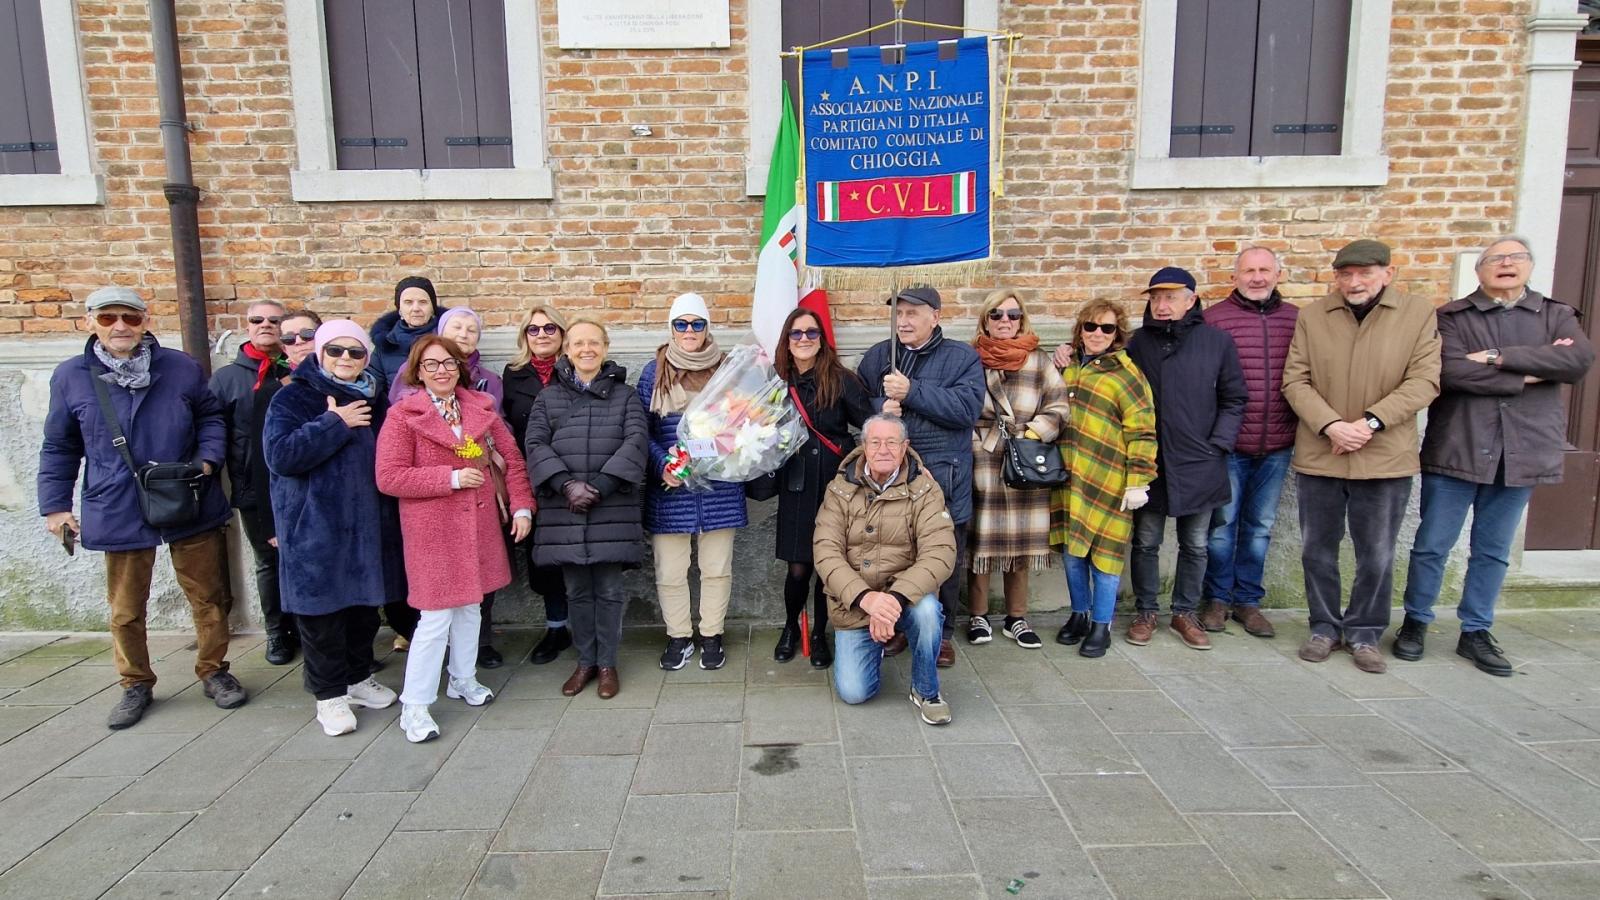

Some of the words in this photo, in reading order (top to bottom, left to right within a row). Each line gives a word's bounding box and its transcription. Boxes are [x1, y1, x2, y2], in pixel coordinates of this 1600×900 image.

[809, 97, 903, 116] ASSOCIAZIONE
[908, 91, 984, 111] NAZIONALE
[823, 116, 903, 133] PARTIGIANI
[909, 112, 970, 129] D'ITALIA
[810, 135, 878, 151] COMITATO
[886, 130, 964, 147] COMUNALE
[970, 127, 984, 141] DI
[850, 151, 942, 170] CHIOGGIA
